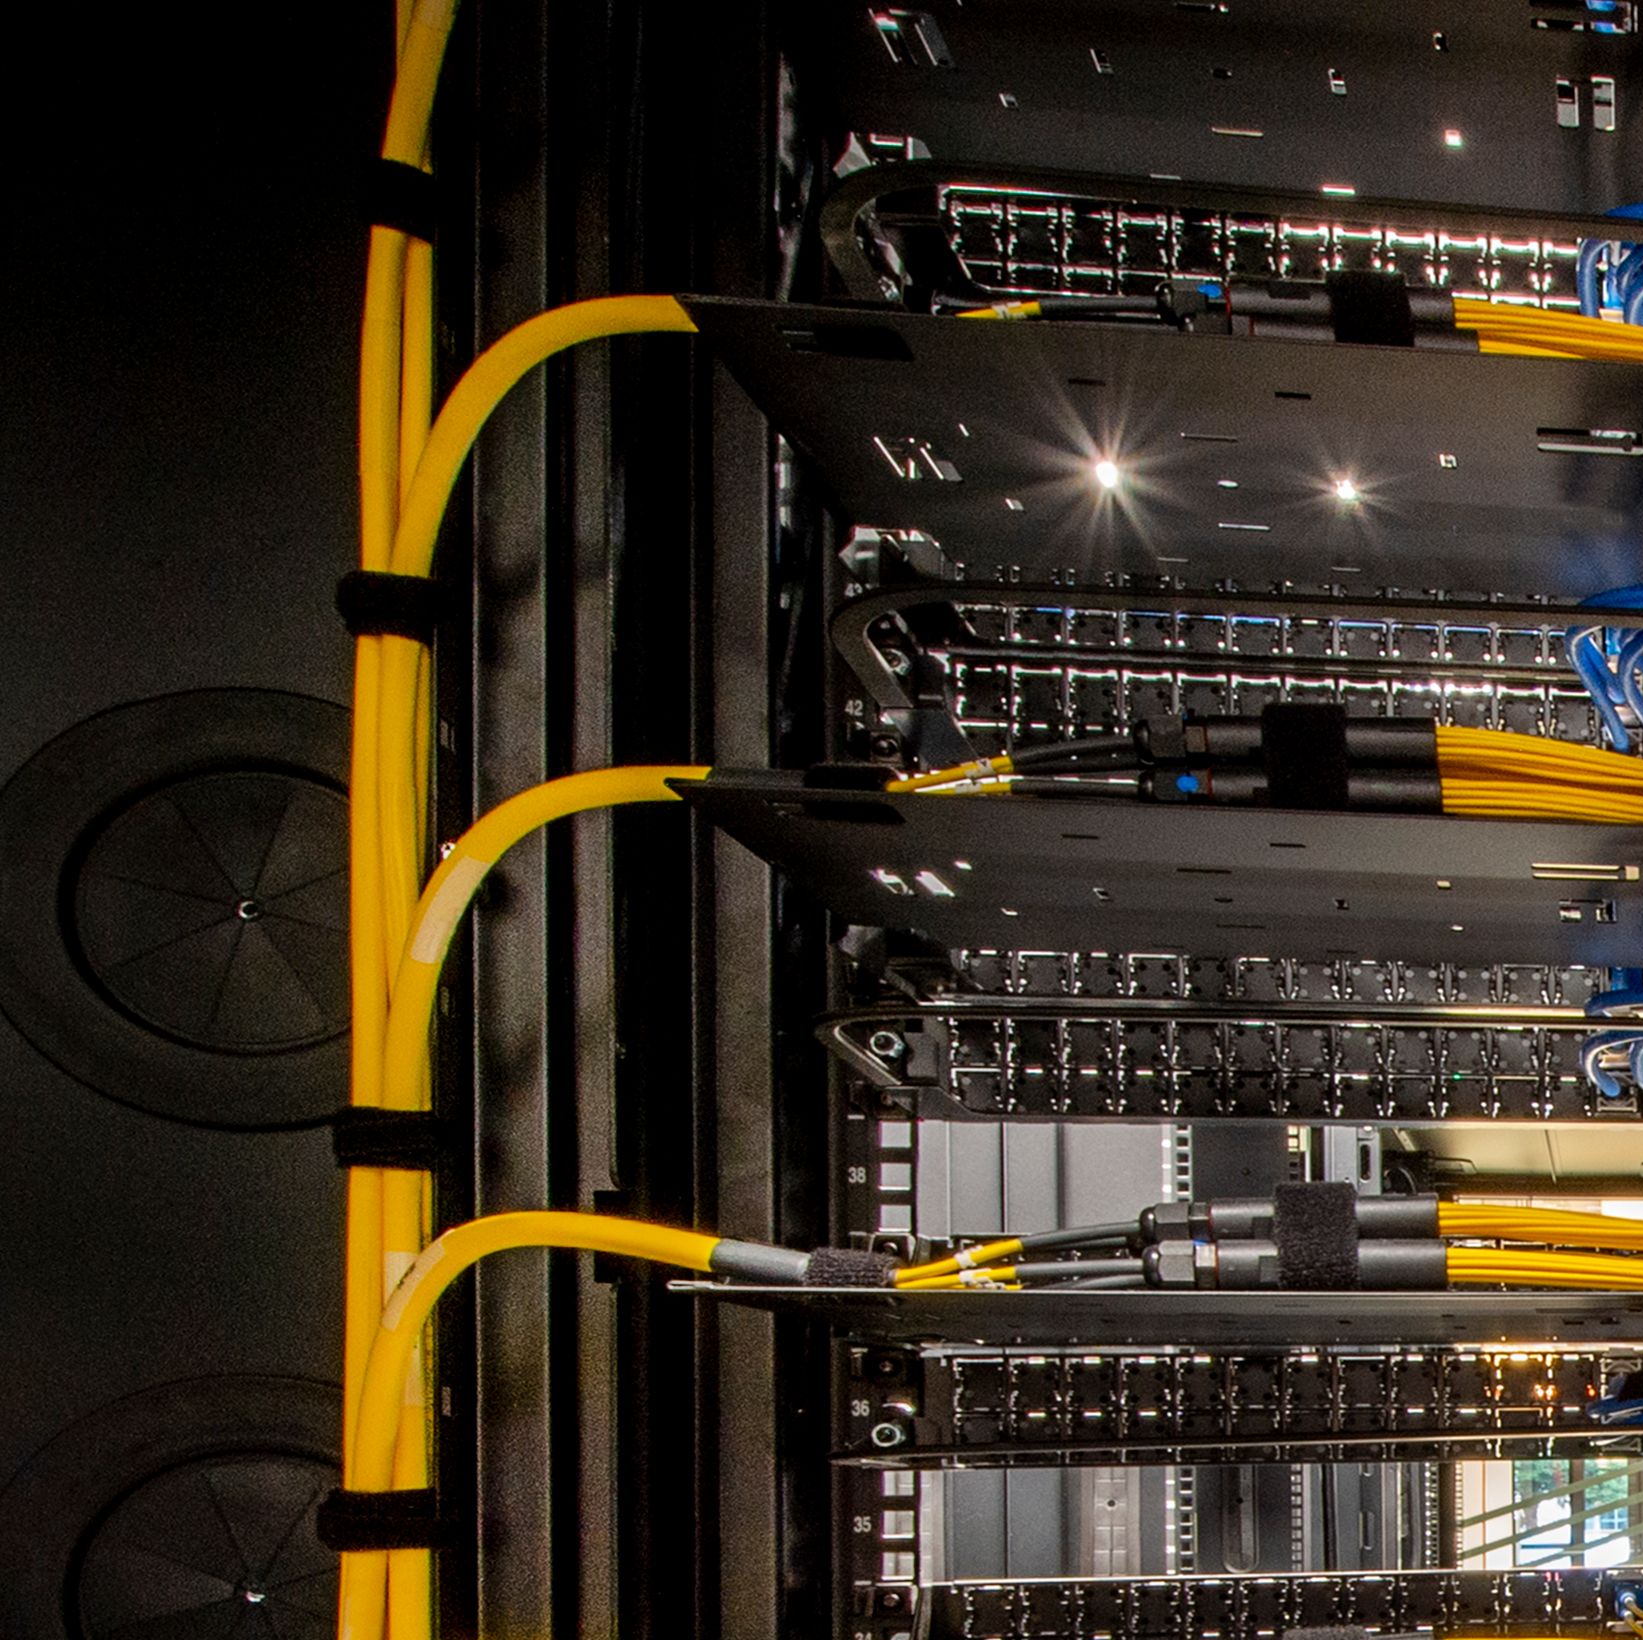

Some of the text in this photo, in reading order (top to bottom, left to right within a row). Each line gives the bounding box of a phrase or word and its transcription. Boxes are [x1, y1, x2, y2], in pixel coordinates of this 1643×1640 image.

[845, 699, 864, 716] 42
[847, 1166, 866, 1184] 38
[851, 1400, 870, 1417] 36
[853, 1516, 871, 1533] 35
